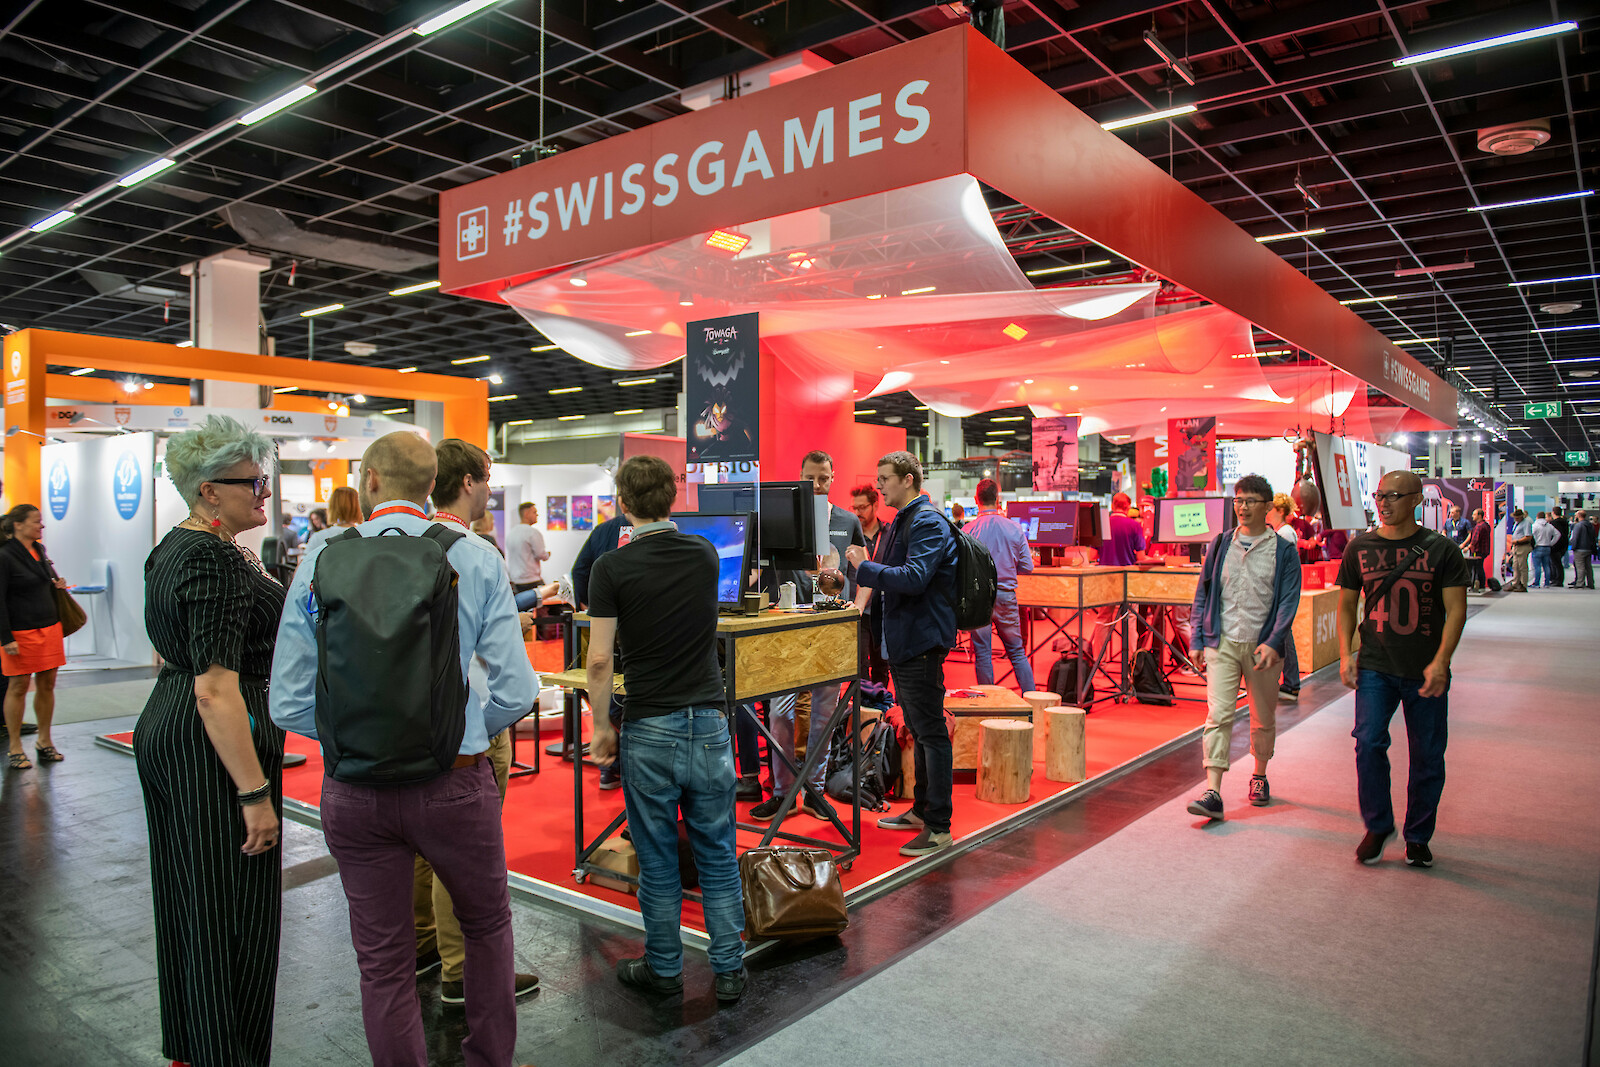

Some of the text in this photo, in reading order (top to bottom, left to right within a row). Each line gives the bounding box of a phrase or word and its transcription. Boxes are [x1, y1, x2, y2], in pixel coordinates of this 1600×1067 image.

[502, 80, 931, 246] #SWISSGAMES
[704, 325, 738, 343] TOWAGA
[1391, 358, 1430, 402] #SWISSGAMES
[271, 416, 292, 424] DGA
[1176, 419, 1199, 428] ALAN
[1369, 579, 1419, 635] 40
